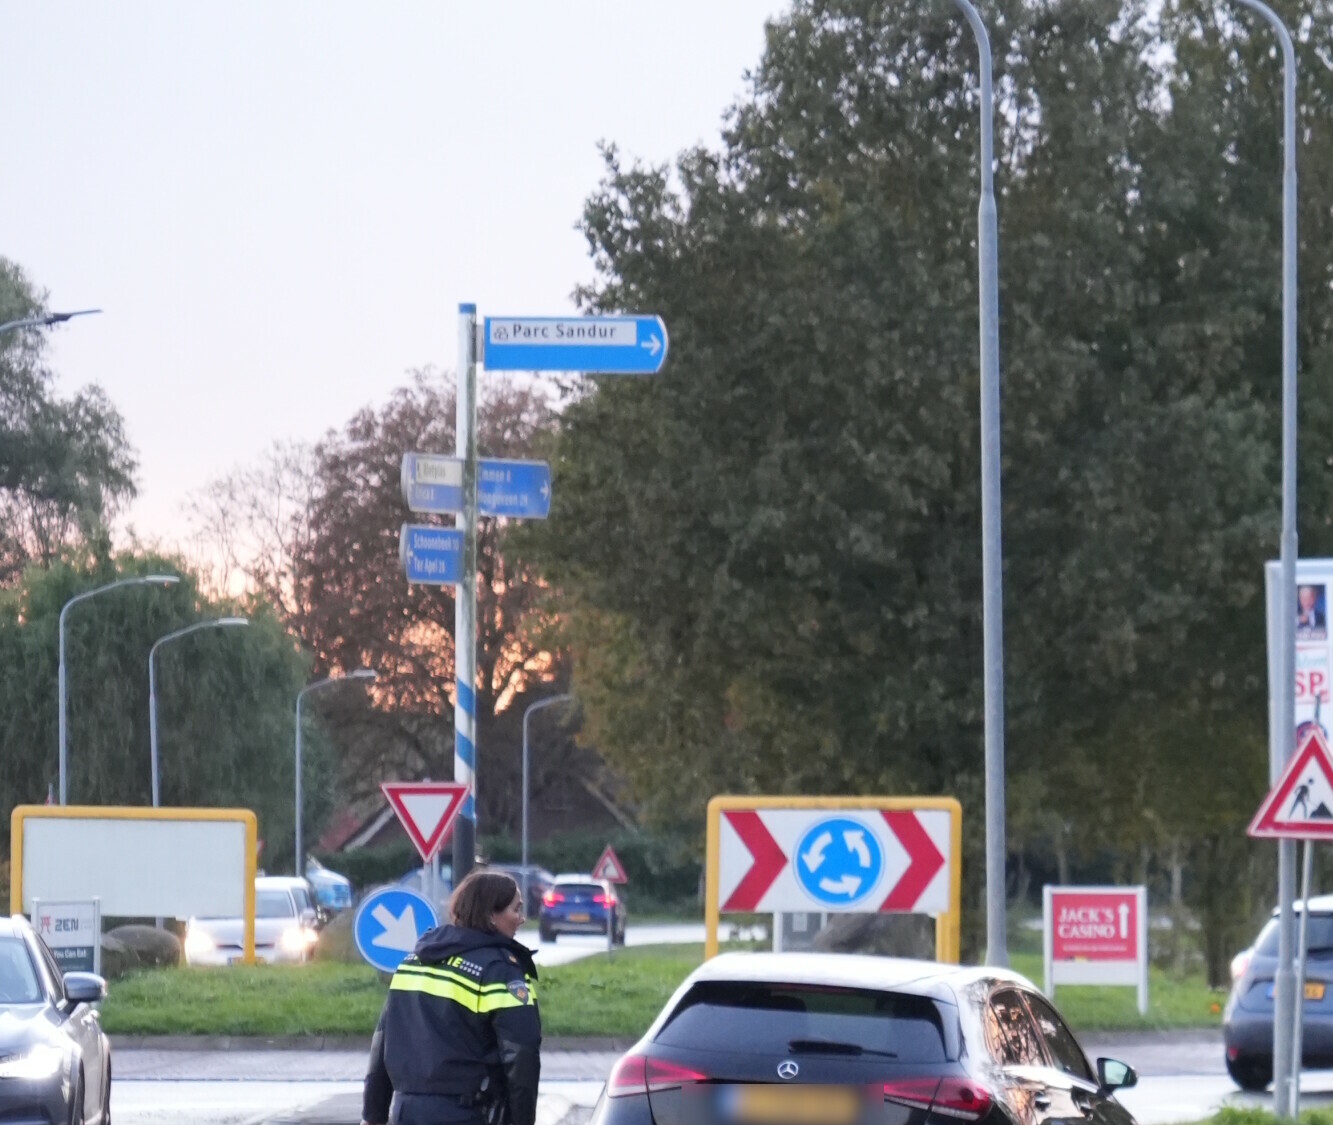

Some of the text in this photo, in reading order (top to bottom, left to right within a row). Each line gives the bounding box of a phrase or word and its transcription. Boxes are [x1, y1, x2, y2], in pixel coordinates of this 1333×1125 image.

[512, 323, 617, 338] Parc Sandur
[1059, 905, 1115, 923] JACK'S
[1058, 923, 1116, 939] CASINO
